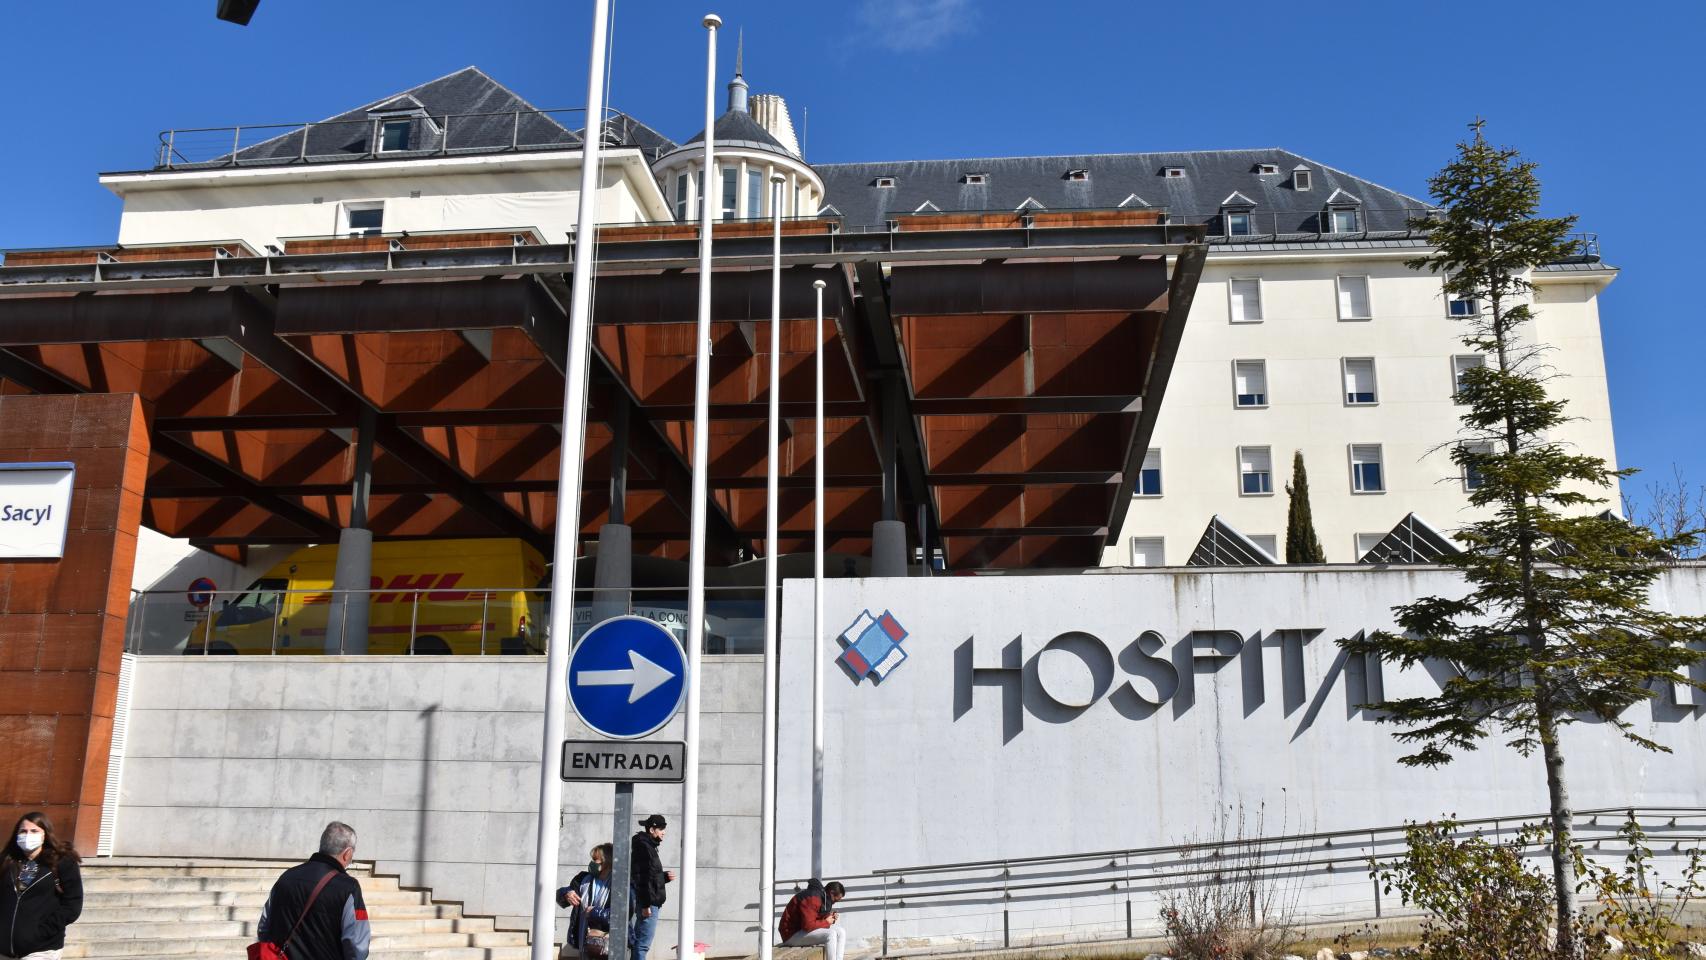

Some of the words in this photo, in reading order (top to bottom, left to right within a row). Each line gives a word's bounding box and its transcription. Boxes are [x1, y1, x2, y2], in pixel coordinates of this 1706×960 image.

[2, 505, 52, 526] Sacyl
[370, 572, 464, 603] HL
[572, 752, 673, 770] ENTRADA
